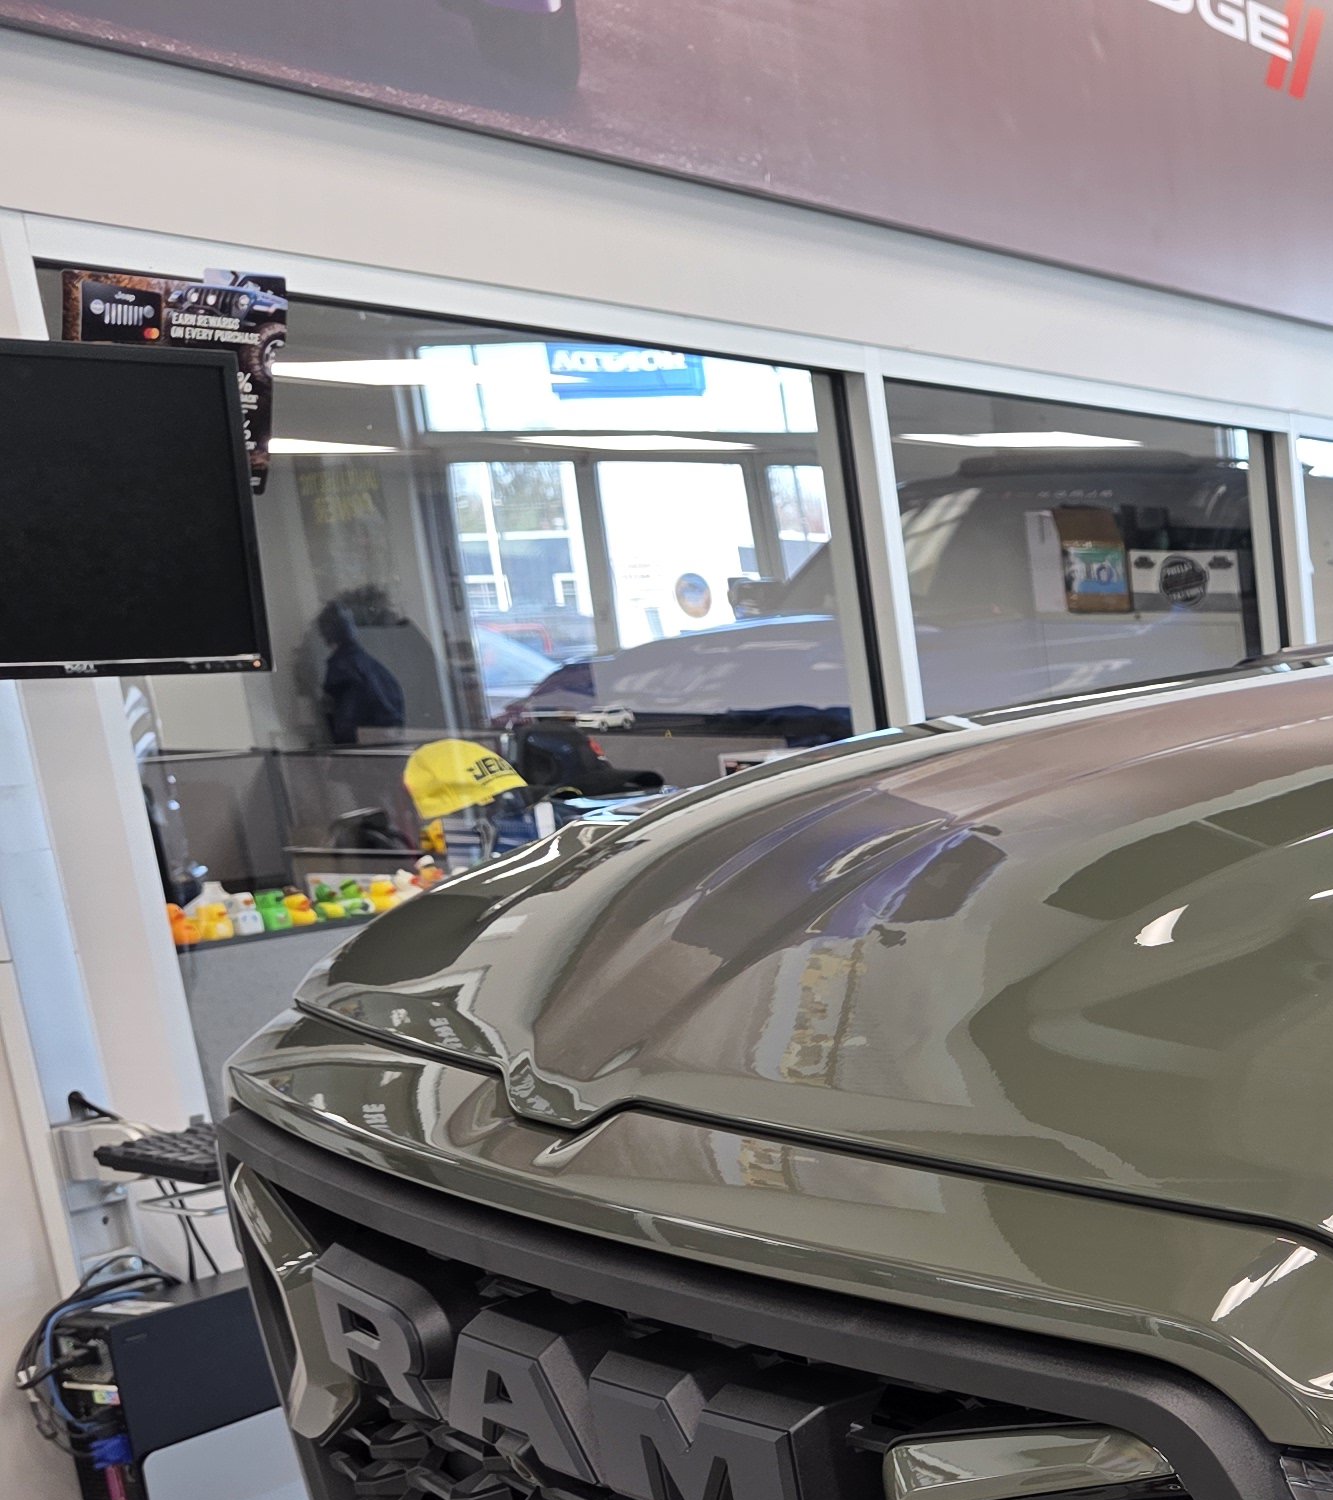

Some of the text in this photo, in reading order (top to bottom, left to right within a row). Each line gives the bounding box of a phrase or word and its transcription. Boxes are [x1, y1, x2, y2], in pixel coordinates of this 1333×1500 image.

[171, 313, 197, 327] EARN
[170, 326, 262, 345] ON EVERY PURCHASE
